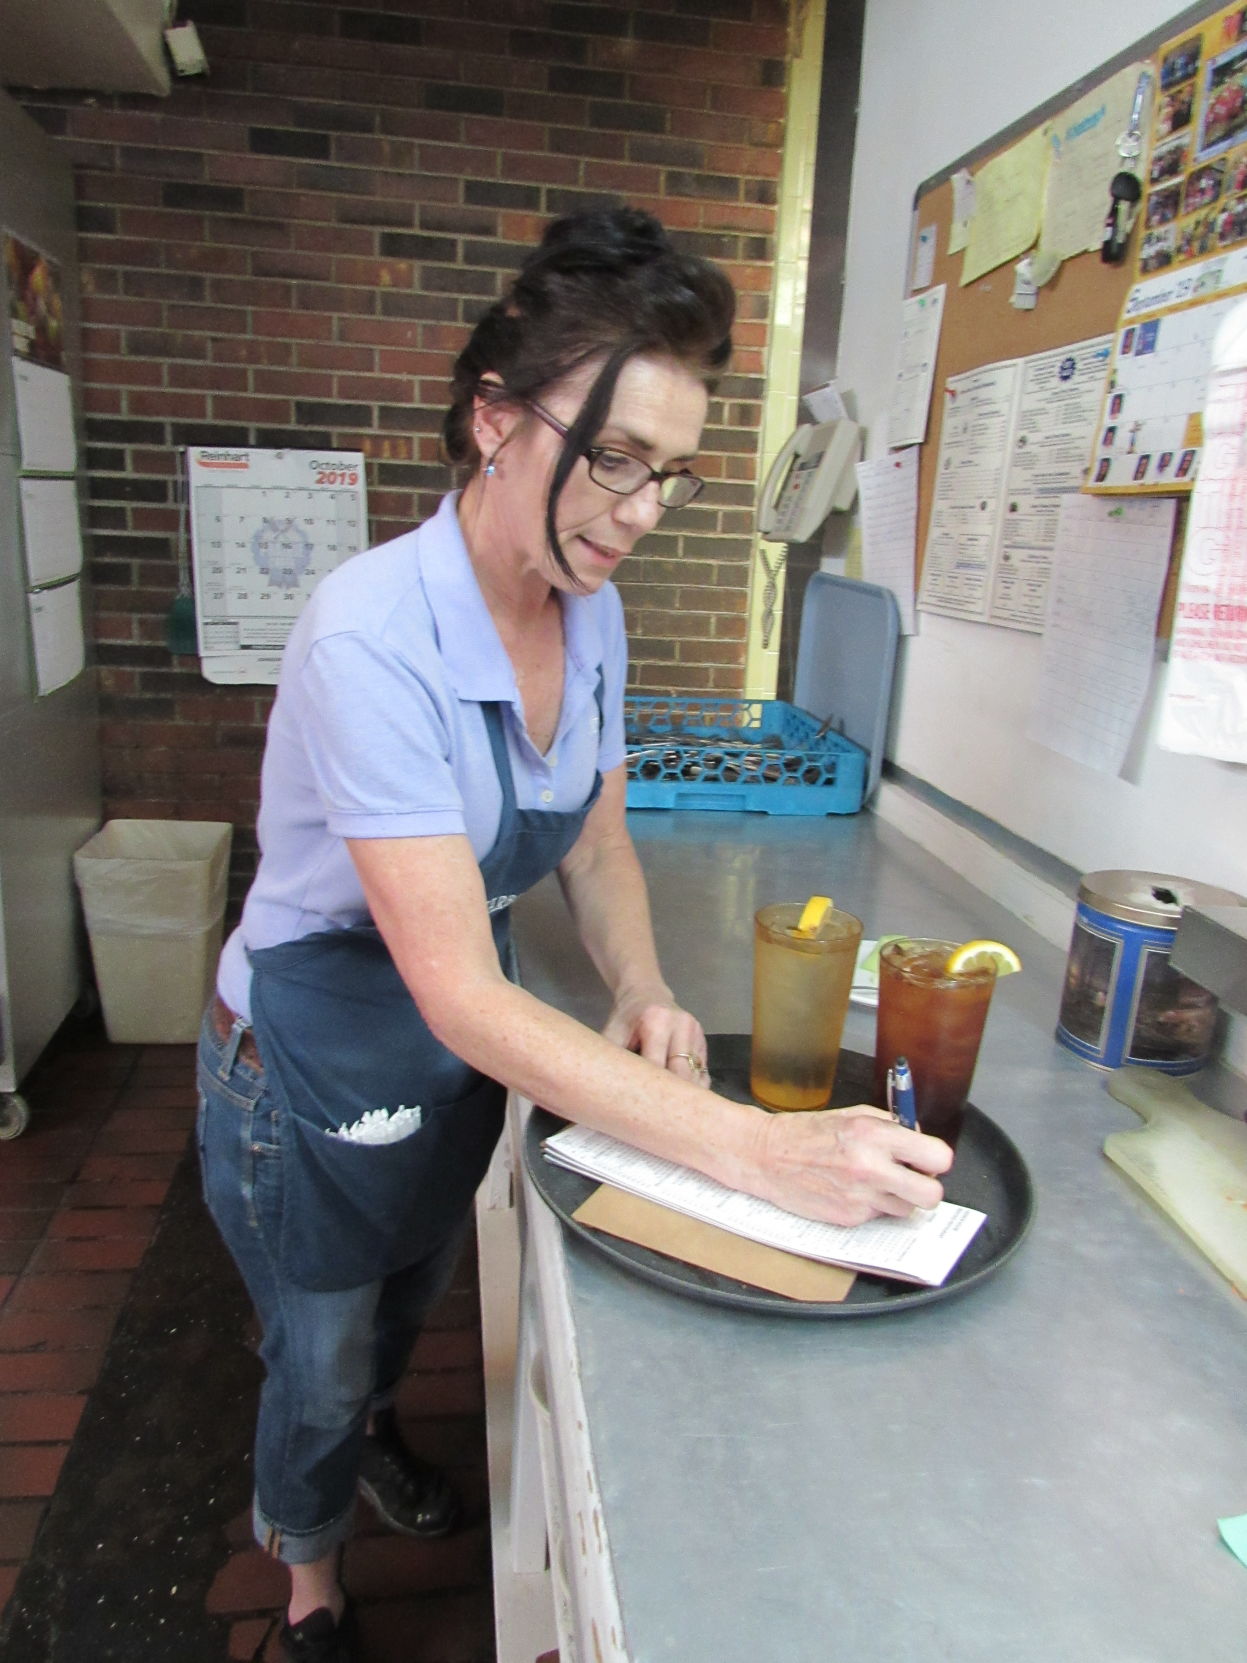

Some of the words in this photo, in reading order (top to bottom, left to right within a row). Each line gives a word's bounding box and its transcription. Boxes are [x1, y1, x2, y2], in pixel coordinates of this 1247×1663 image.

[200, 450, 250, 462] Reinhart
[309, 460, 358, 471] October
[314, 471, 358, 486] 2019
